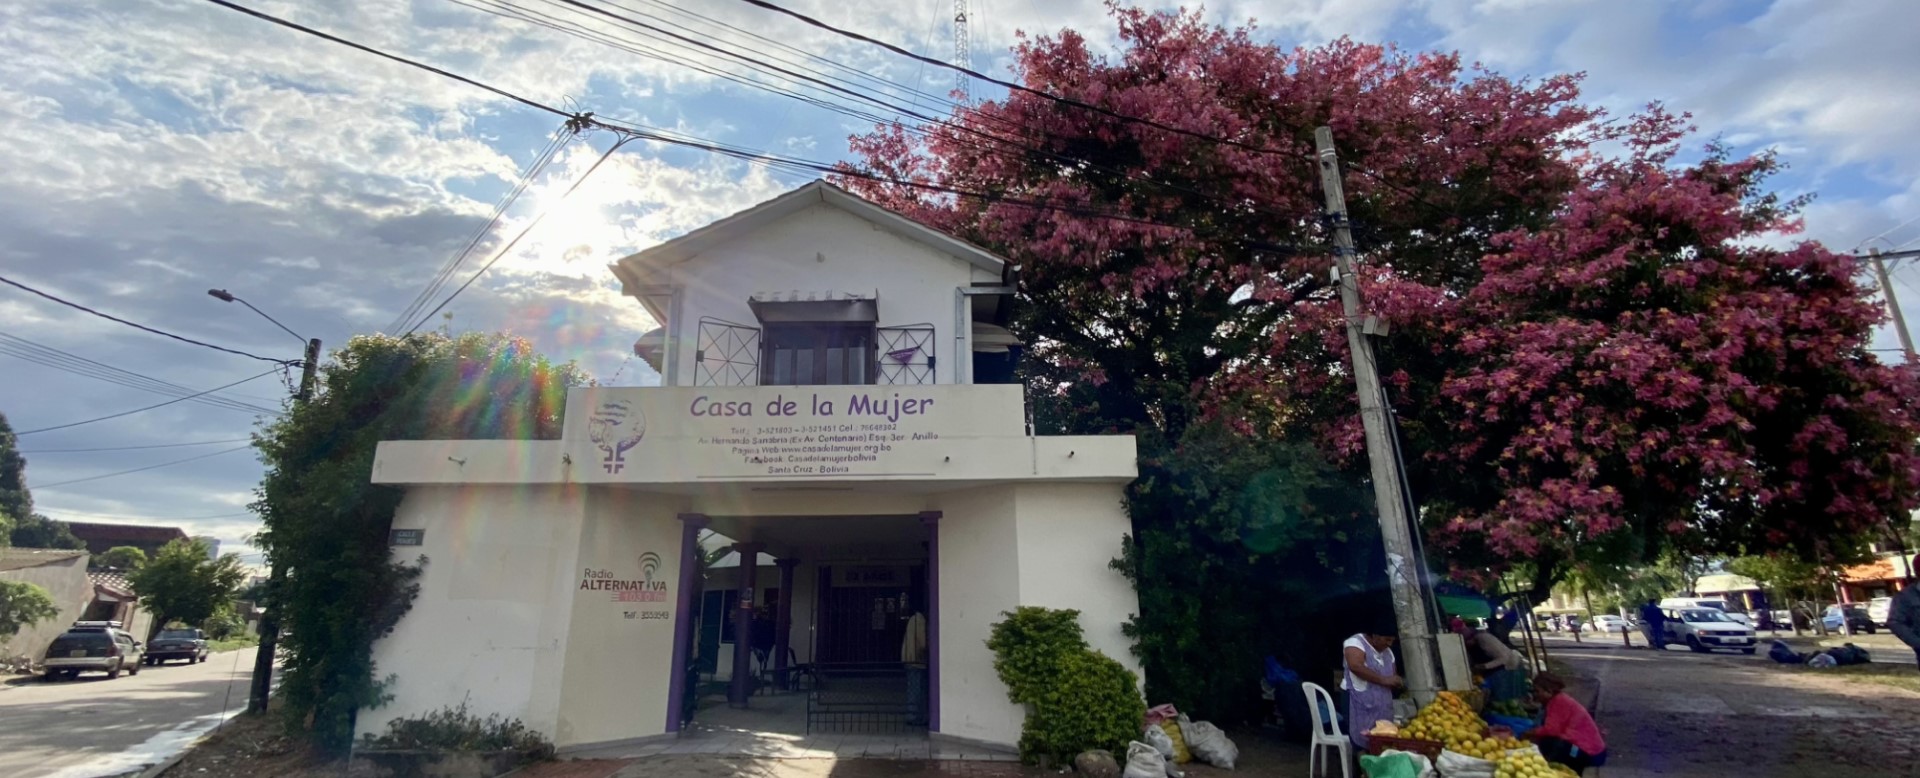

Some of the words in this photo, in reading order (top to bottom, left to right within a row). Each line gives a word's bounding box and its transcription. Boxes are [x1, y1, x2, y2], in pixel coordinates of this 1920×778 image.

[690, 395, 752, 417] Casa
[766, 394, 797, 416] de
[812, 393, 833, 416] la
[847, 393, 934, 423] Mujer
[711, 436, 750, 445] Hernando
[752, 436, 788, 445] Sanabria
[911, 431, 939, 441] Anillo
[767, 465, 792, 474] Santa
[793, 465, 813, 474] Cruz
[819, 465, 849, 473] Bolivia
[584, 568, 614, 579] Radio
